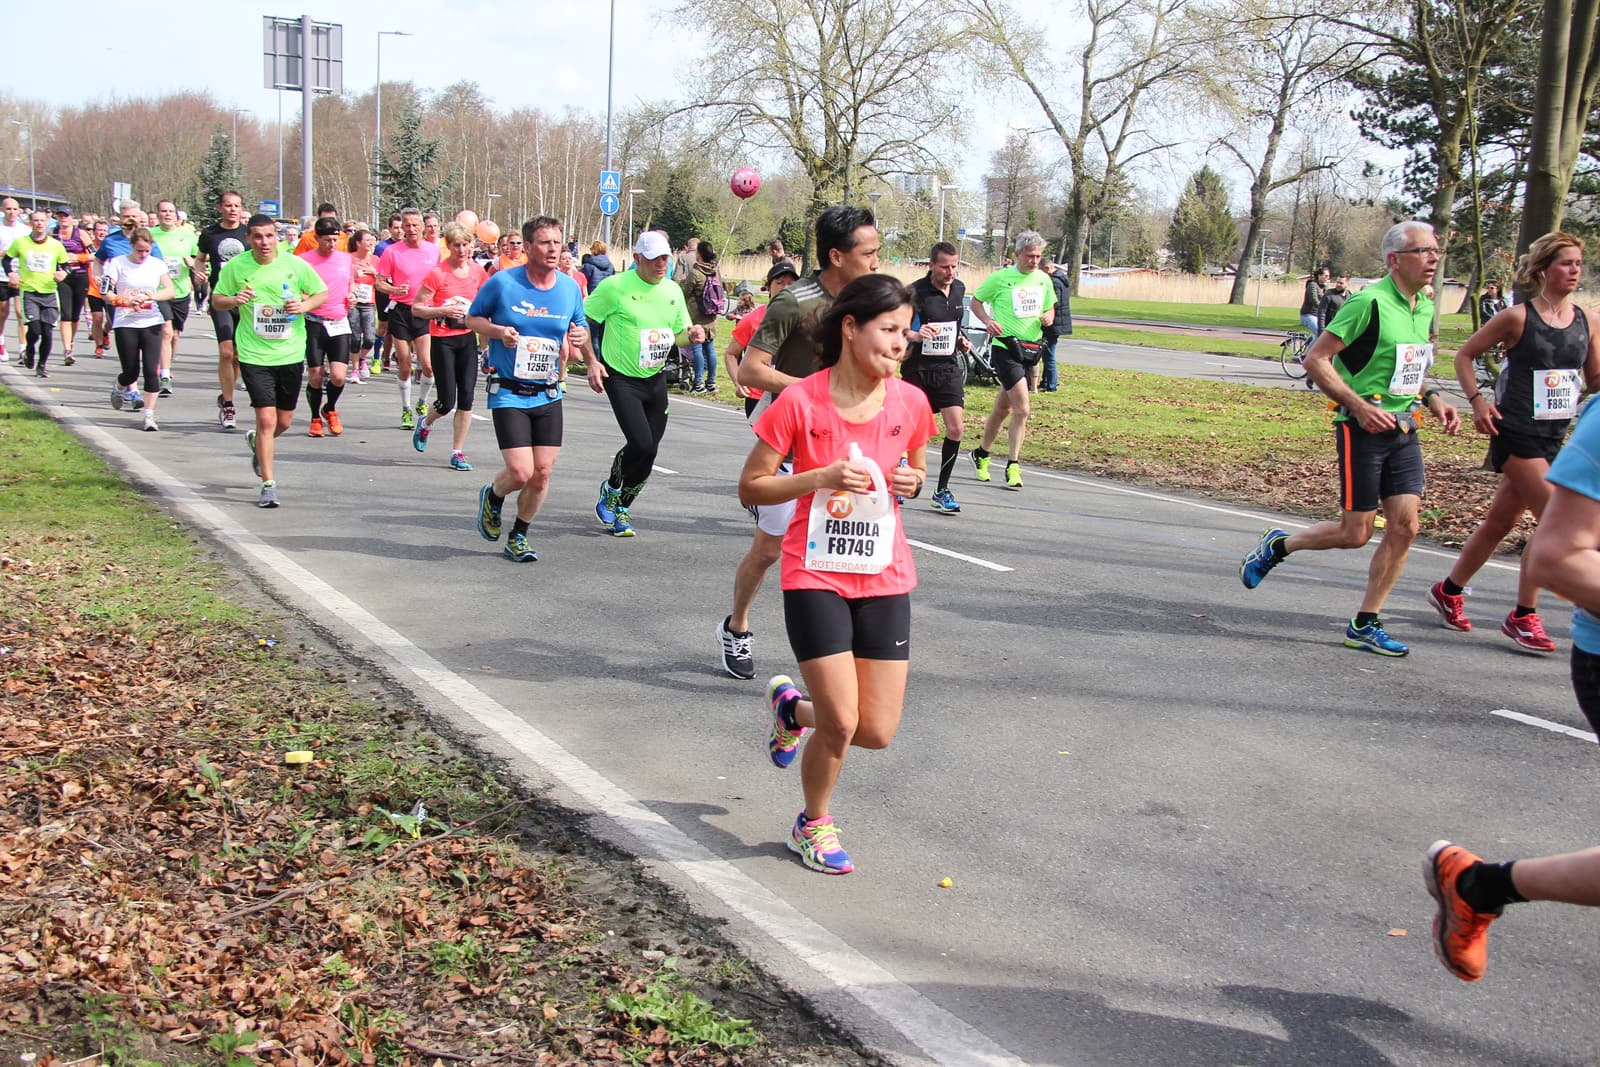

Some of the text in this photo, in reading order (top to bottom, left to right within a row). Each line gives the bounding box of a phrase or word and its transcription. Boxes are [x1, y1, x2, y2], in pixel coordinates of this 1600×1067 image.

[264, 324, 285, 333] 10677
[542, 343, 554, 352] NN
[932, 342, 950, 350] 13101
[1548, 398, 1571, 410] F8831
[825, 519, 880, 538] FABIOLA
[827, 537, 875, 557] F8749
[811, 560, 868, 572] ROTTERDAM
